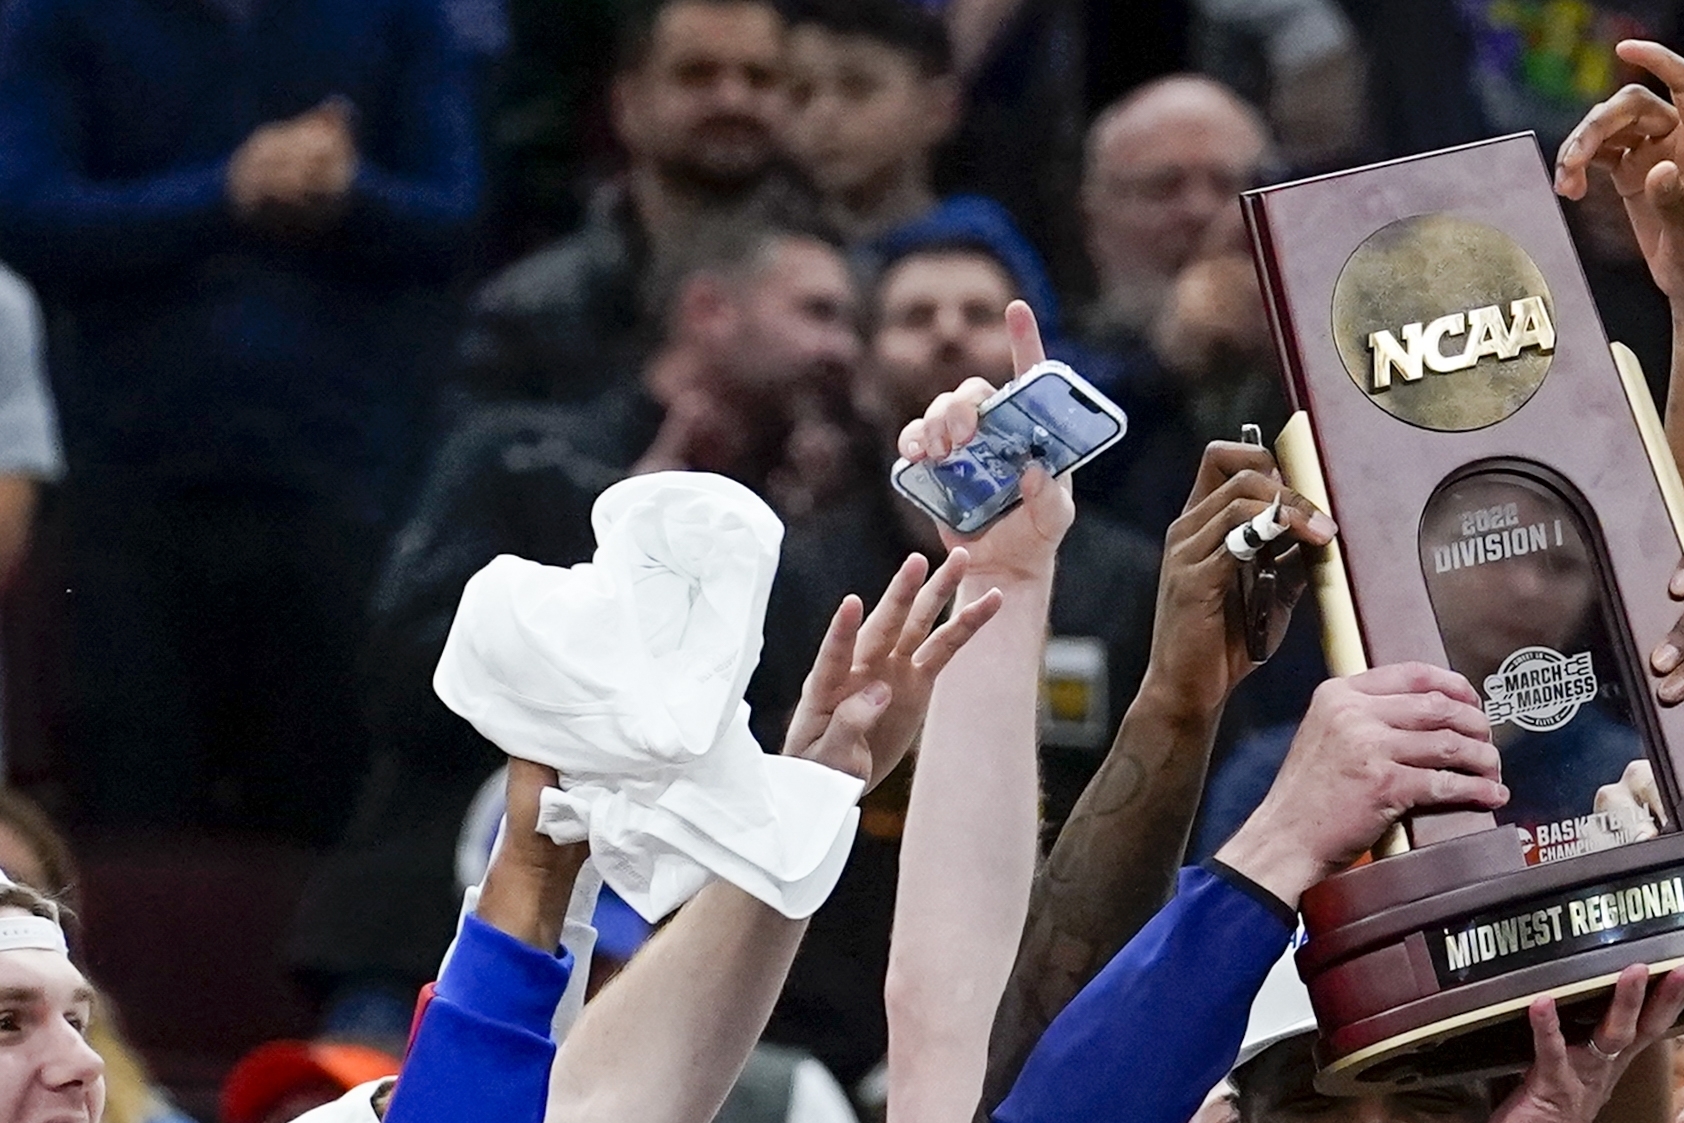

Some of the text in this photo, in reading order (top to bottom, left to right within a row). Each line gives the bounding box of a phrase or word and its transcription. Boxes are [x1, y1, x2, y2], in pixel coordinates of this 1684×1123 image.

[1369, 295, 1556, 390] NCAA
[1461, 502, 1520, 536] 2022
[1433, 522, 1548, 574] DIVISION
[1504, 664, 1563, 693] MARCH
[1516, 675, 1595, 709] MADNESS
[1536, 801, 1655, 847] BASKETBLL
[1445, 906, 1565, 972] MIDWEST
